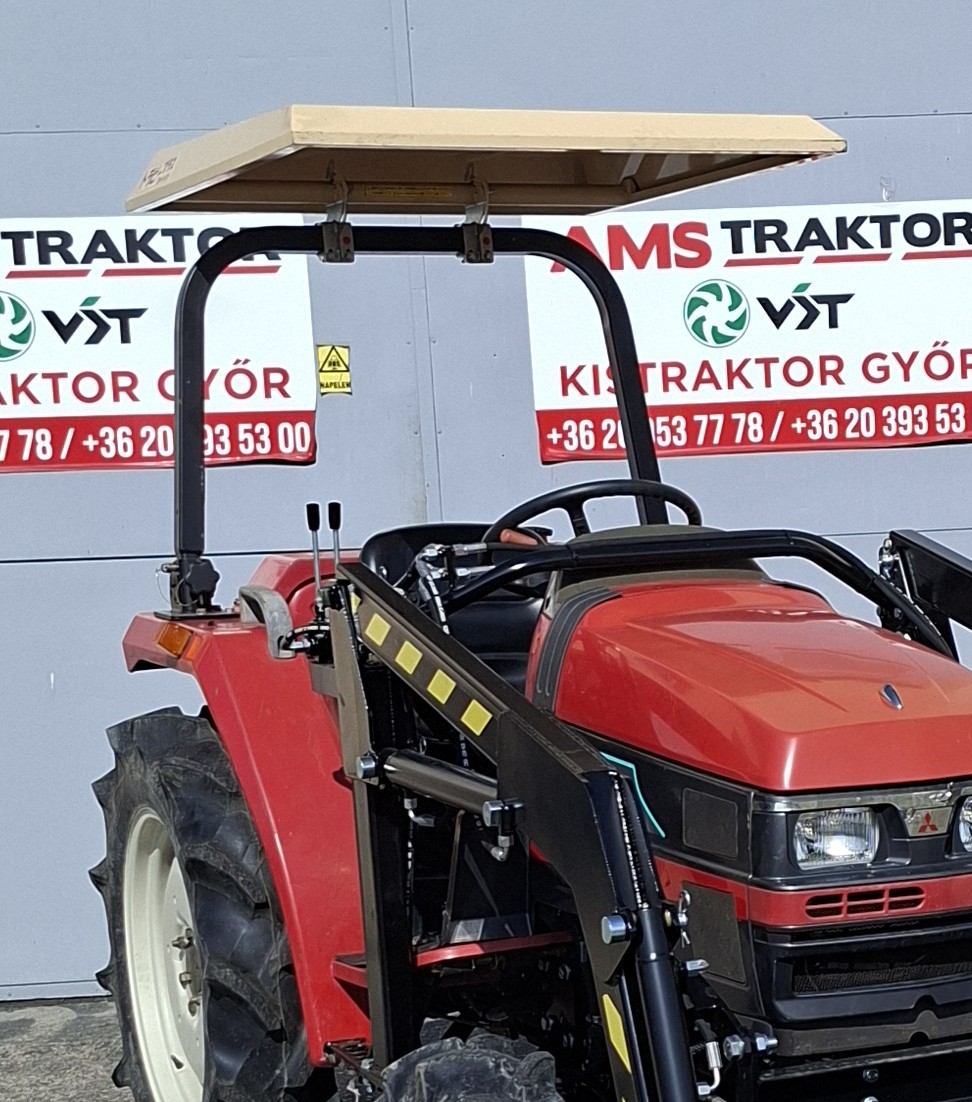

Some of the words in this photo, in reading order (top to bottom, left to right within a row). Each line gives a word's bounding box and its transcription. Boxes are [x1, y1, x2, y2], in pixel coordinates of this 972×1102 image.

[17, 428, 53, 461] 78
[60, 427, 75, 460] /
[82, 426, 134, 458] +36
[140, 425, 174, 457] 20
[238, 422, 272, 455] 53
[278, 421, 311, 453] 00
[547, 419, 595, 451] +36
[602, 419, 626, 450] 2
[693, 413, 724, 445] 77
[731, 412, 763, 443] 78
[770, 411, 784, 441] /
[791, 409, 837, 440] +36
[845, 407, 876, 438] 20
[882, 404, 928, 436] 393
[935, 402, 965, 434] 53
